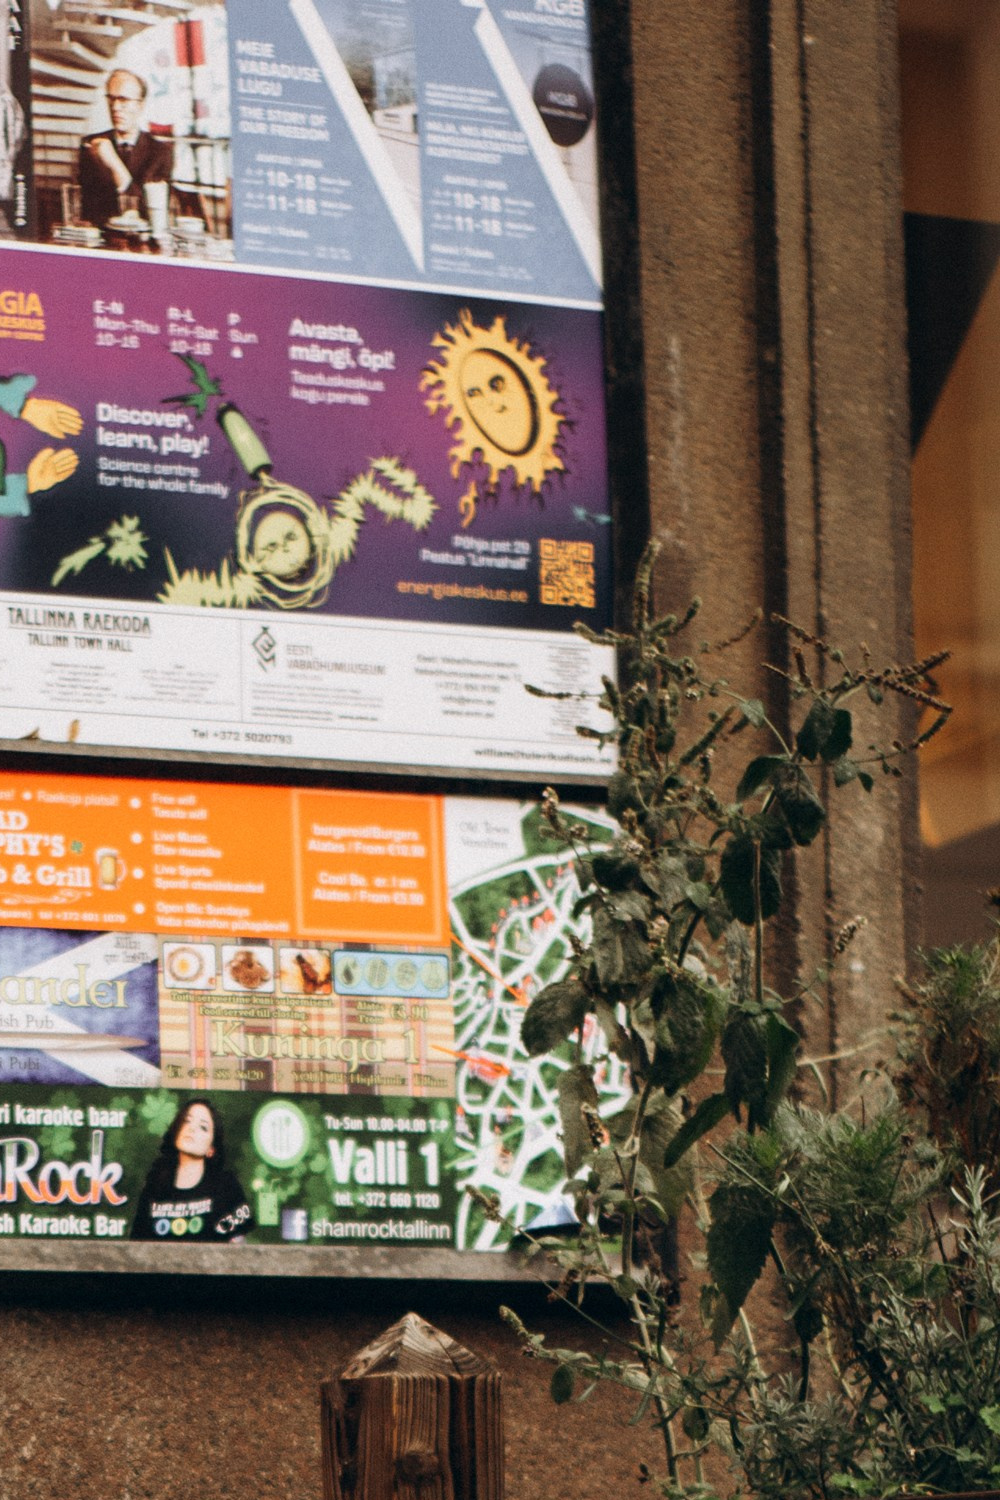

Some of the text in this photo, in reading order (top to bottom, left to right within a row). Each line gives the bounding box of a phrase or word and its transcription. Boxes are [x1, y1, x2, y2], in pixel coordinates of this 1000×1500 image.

[238, 59, 323, 83] VABADUSE
[239, 105, 328, 127] THE STORY OF
[240, 121, 330, 141] OUR FREEDOM
[228, 312, 241, 326] P
[228, 328, 259, 344] Sun
[289, 318, 364, 345] Avasta,
[96, 402, 194, 432] Discover,
[97, 426, 210, 458] learn, play!
[98, 457, 200, 477] Science centre
[98, 472, 230, 499] for the whole family
[396, 580, 528, 602] energiakeskus.ee
[8, 607, 153, 633] TALLINNA RAEKODA
[28, 633, 134, 652] TALLINN TOWN HALL
[192, 729, 209, 740] Tel
[213, 730, 241, 741] +372
[154, 831, 208, 844] Live Music
[354, 841, 386, 855] From
[12, 865, 31, 886] &
[36, 865, 92, 888] Grill
[155, 864, 213, 878] Live Sports
[358, 889, 391, 904] From
[156, 901, 250, 920] Open Sundays
[25, 1014, 54, 1030] Pub
[199, 1006, 270, 1018] Food served till
[213, 1020, 420, 1072] Kuninga 1
[9, 1056, 41, 1071] Pubi
[15, 1105, 84, 1127] karaoke
[88, 1107, 128, 1128] baar
[325, 1115, 363, 1131] Tu-Sun
[328, 1138, 439, 1187] Valli 1
[333, 1191, 441, 1209] tel. +372 1120
[20, 1213, 89, 1236] Karaoke
[94, 1214, 126, 1237] Bar
[312, 1217, 451, 1239] shamrocktallinn
